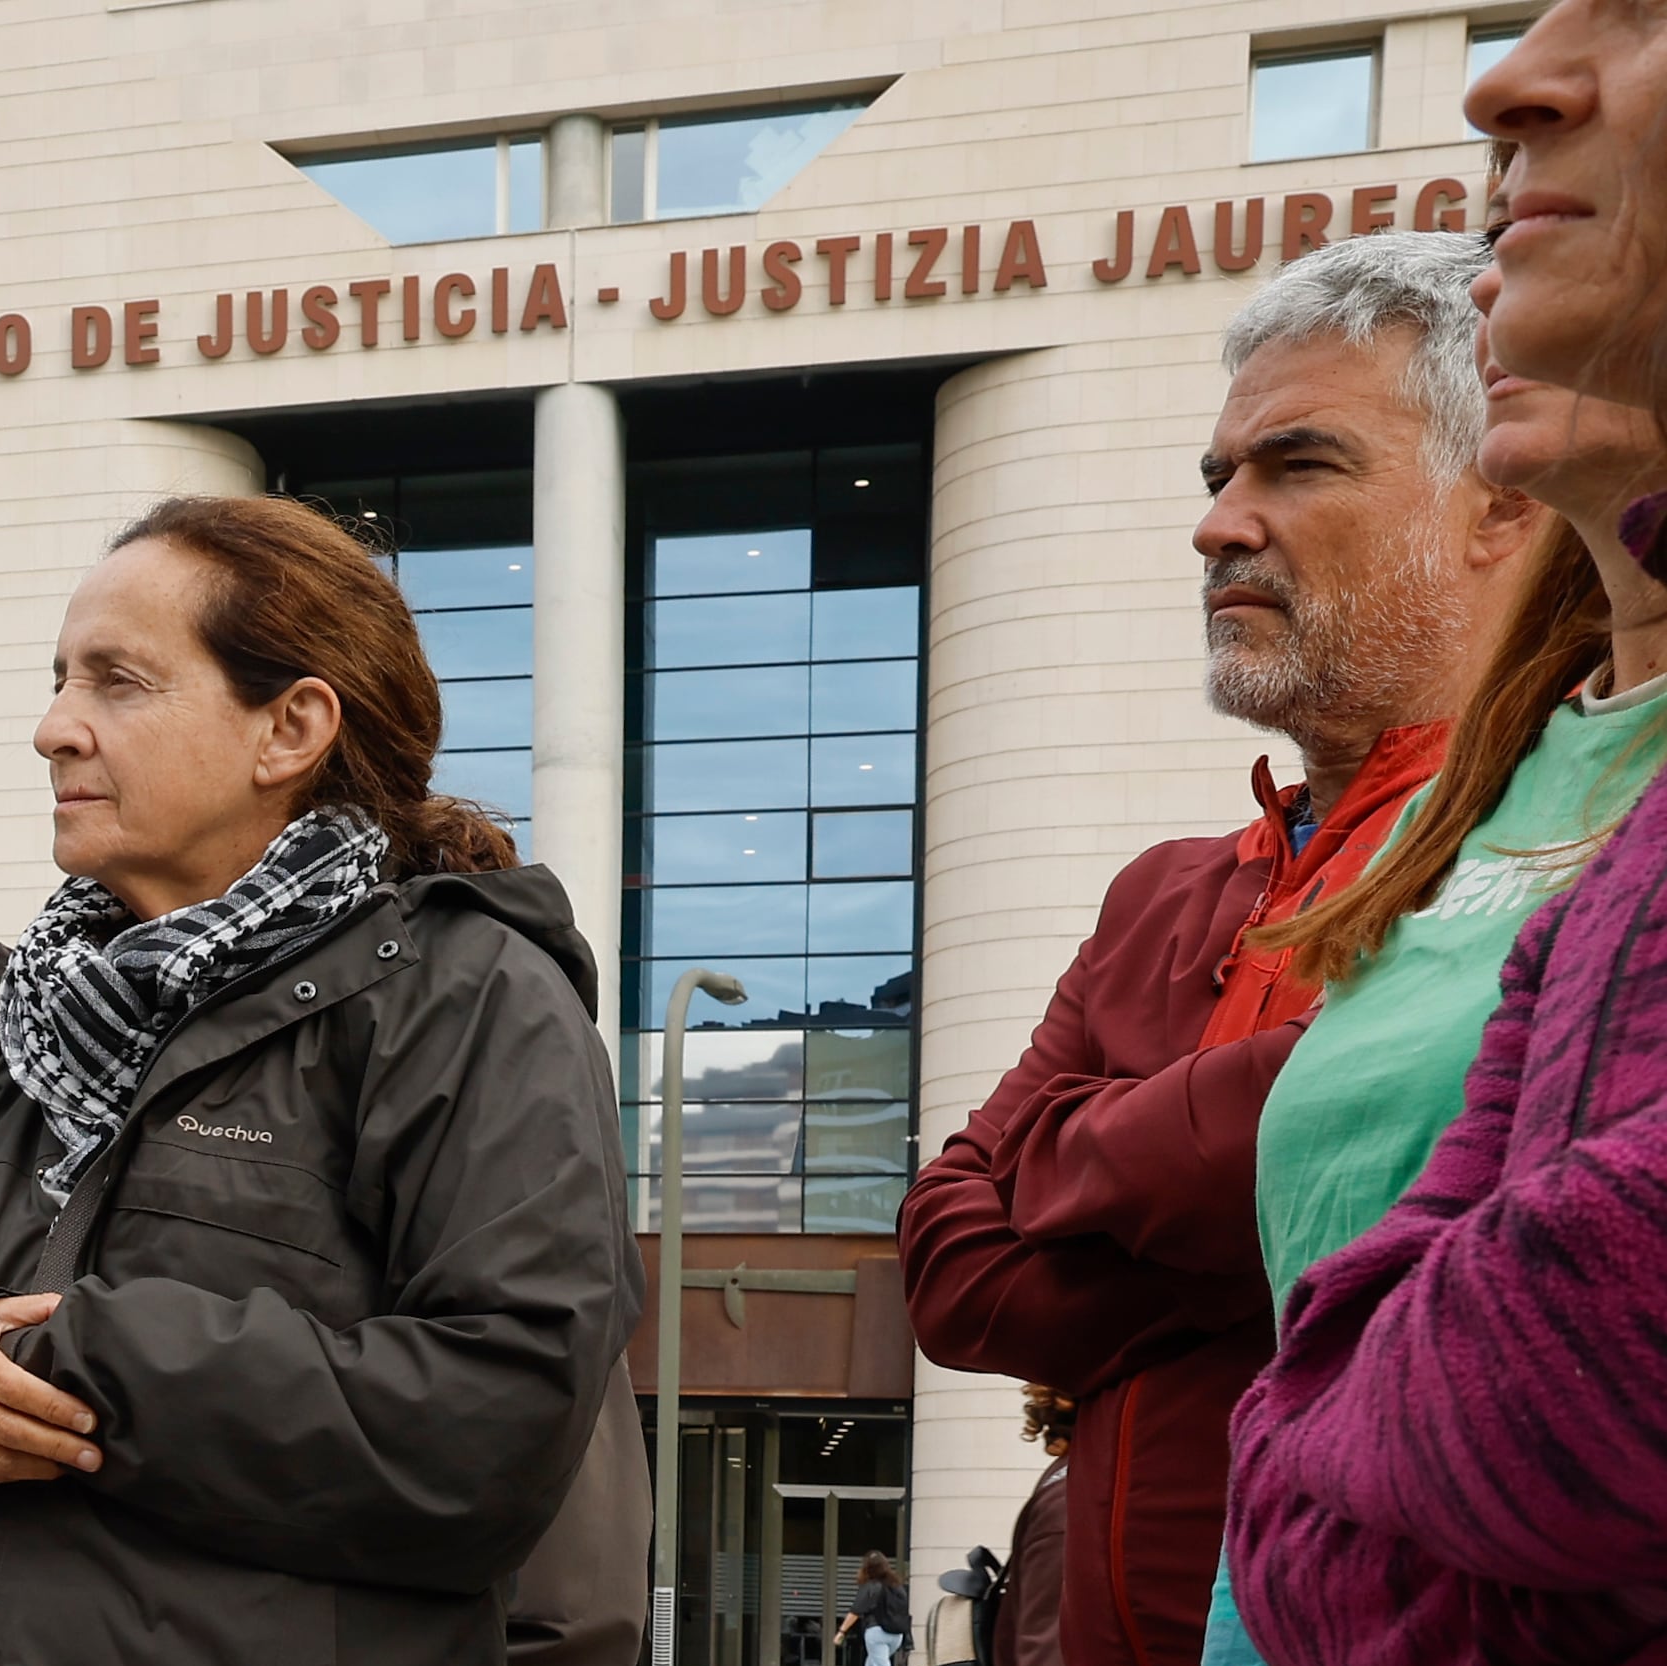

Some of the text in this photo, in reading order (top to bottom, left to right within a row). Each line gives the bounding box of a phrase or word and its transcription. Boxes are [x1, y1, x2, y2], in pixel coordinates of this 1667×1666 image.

[71, 299, 161, 371] DE
[197, 264, 567, 363] JUSTICIA
[650, 220, 1046, 325] JUSTIZIA
[1091, 173, 1499, 284] JAUREG
[176, 1114, 273, 1144] Quechua
